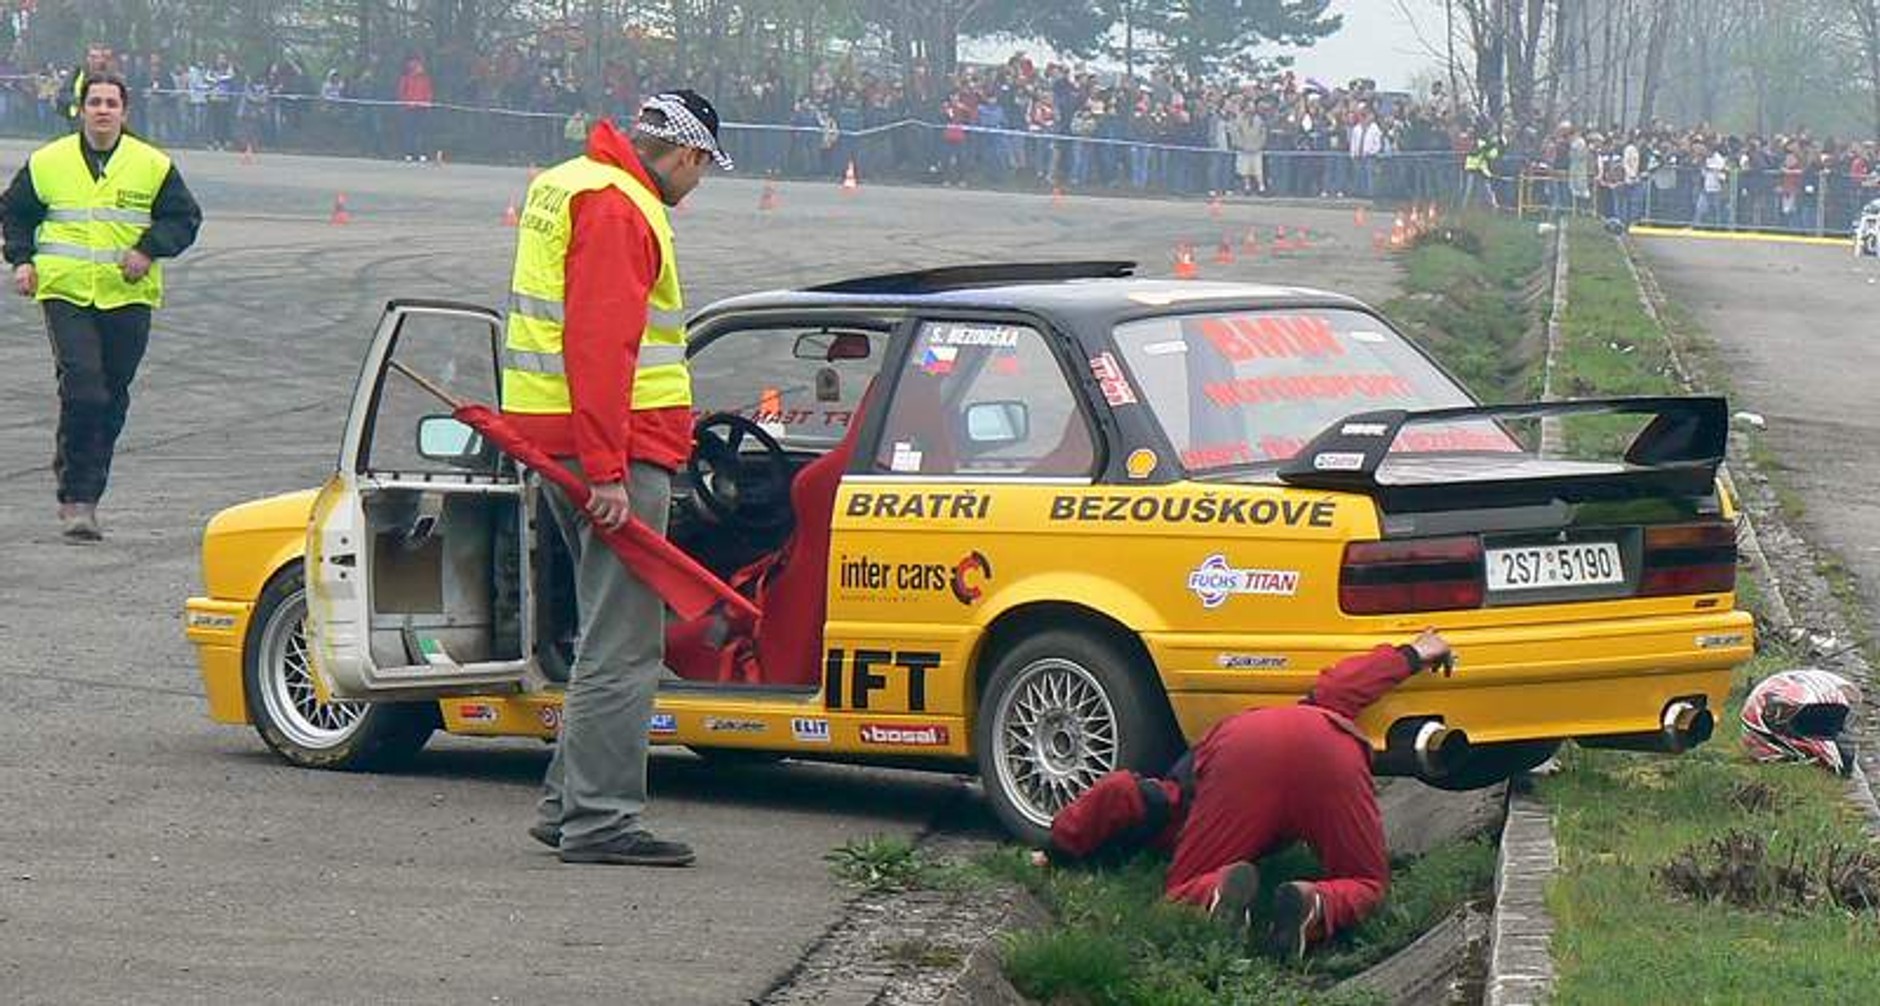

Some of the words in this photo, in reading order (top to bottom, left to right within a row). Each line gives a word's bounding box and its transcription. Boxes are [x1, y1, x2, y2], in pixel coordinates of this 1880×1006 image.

[1203, 315, 1345, 362] BMW
[846, 489, 991, 519] BRATŘI
[1050, 491, 1336, 527] BEZOUŠKOVÉ
[841, 554, 892, 588] inter
[897, 563, 945, 590] cars
[1191, 573, 1238, 589] FUCHS
[1244, 571, 1296, 591] TITAN
[1502, 551, 1541, 584] 2S7
[1558, 548, 1612, 581] 5190
